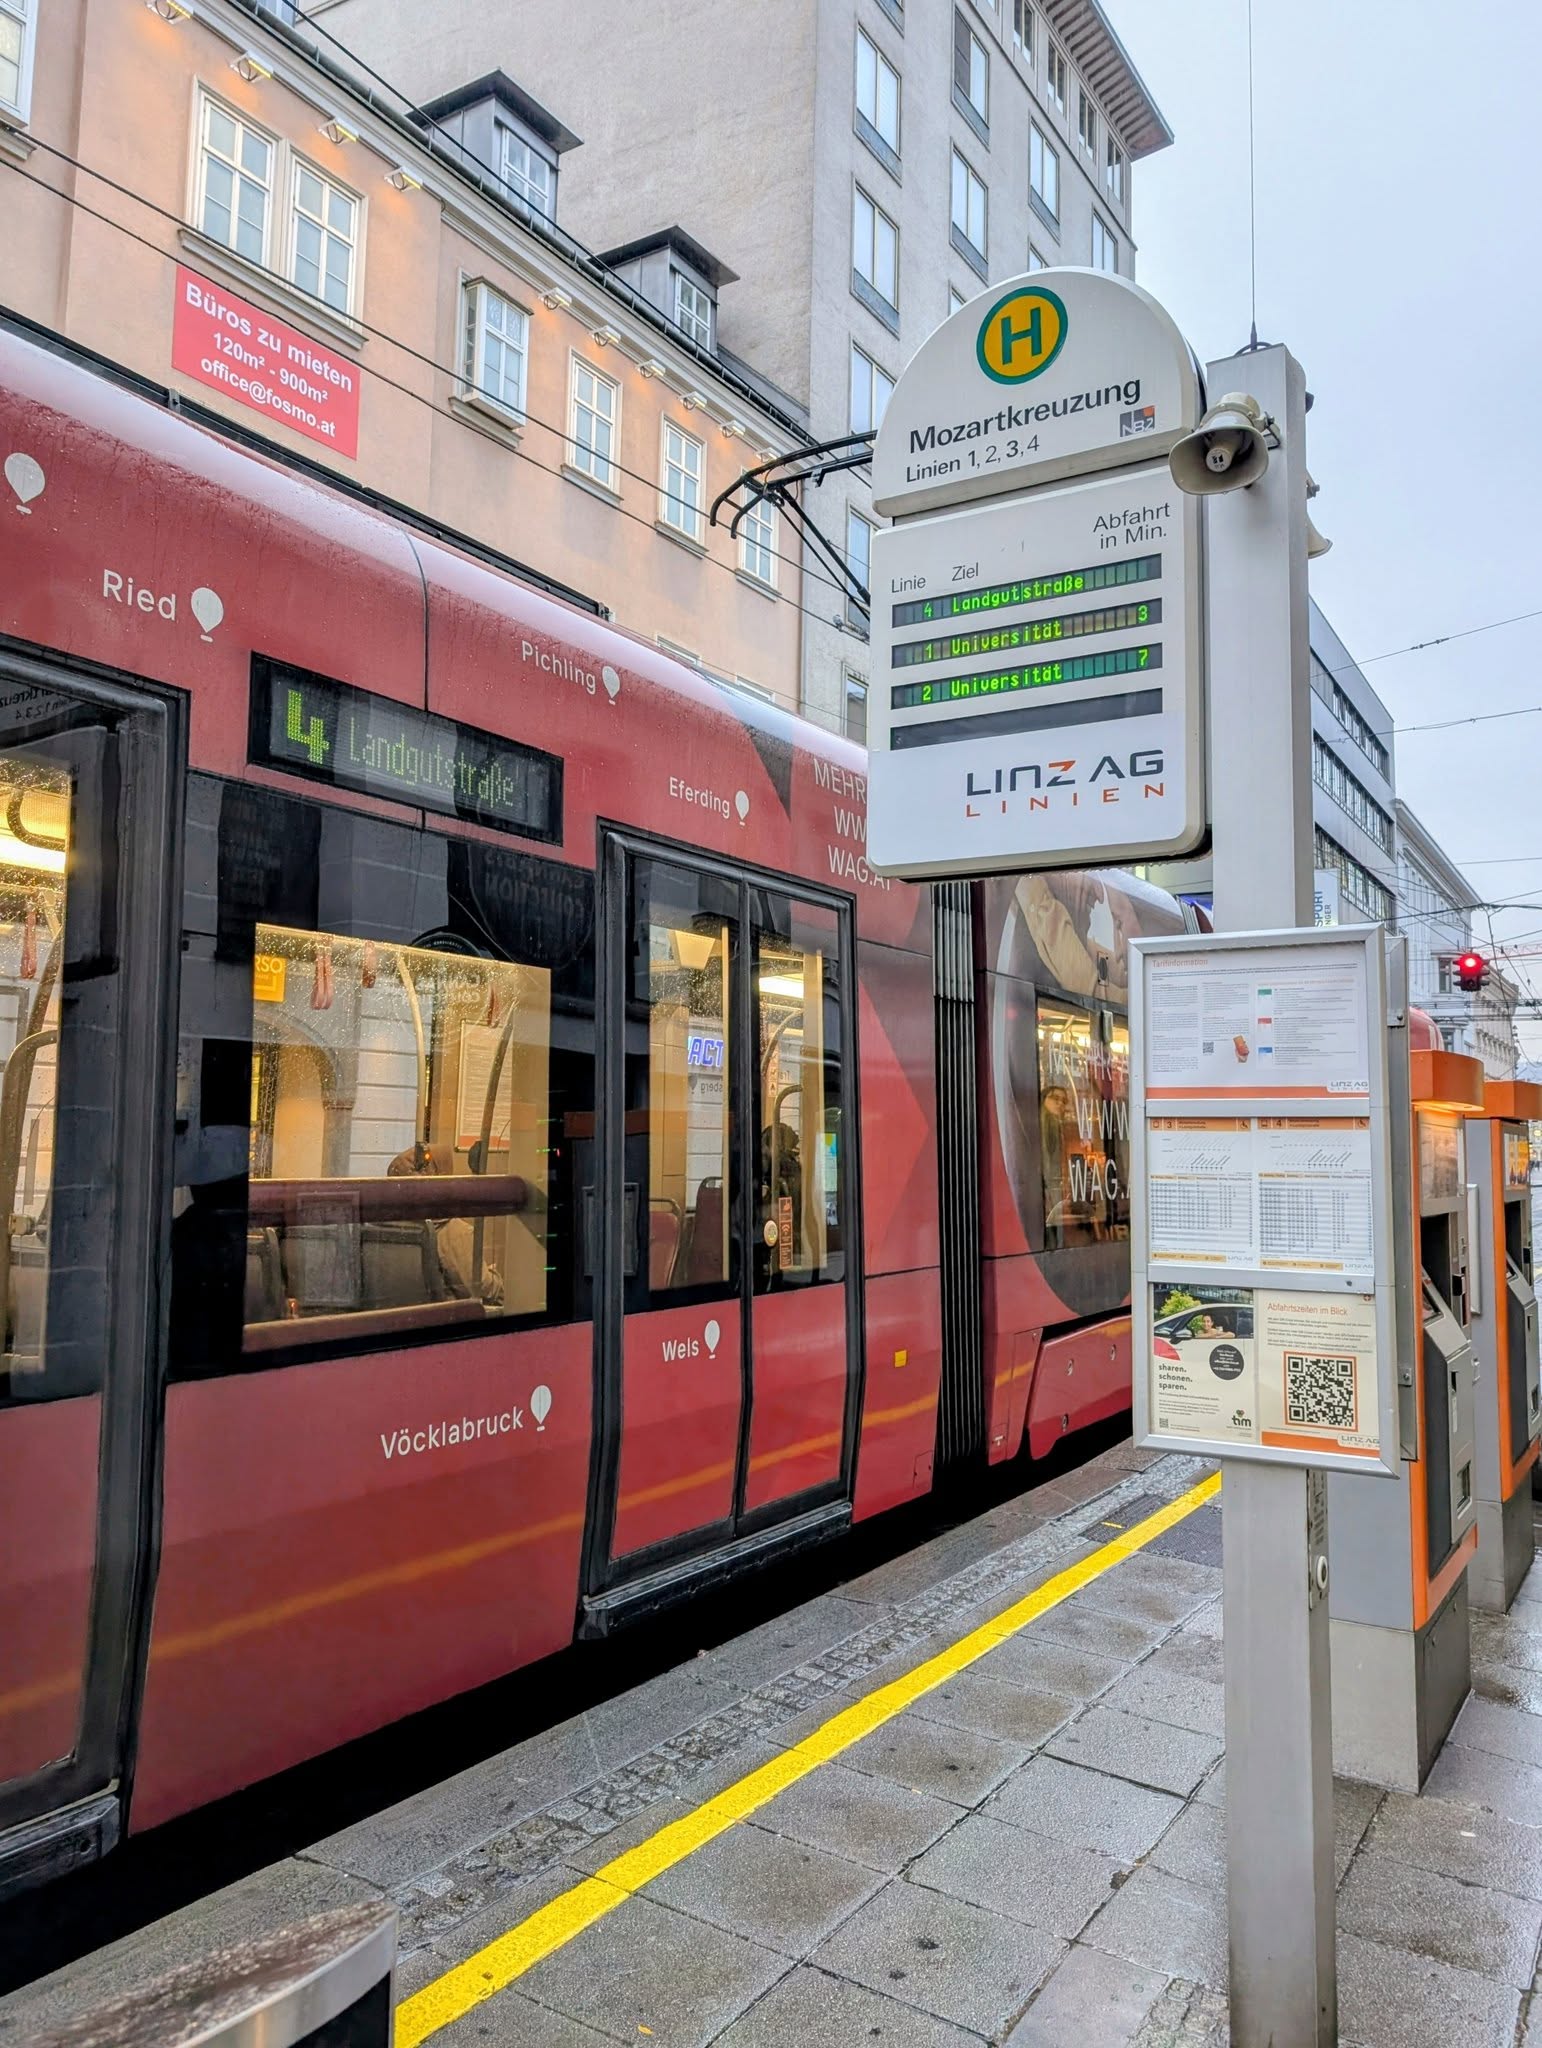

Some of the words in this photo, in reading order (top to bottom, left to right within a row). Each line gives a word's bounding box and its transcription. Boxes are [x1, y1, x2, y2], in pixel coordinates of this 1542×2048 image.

[186, 281, 251, 336] Büros
[257, 327, 281, 353] zu
[287, 343, 352, 393] mieten
[1000, 306, 1042, 366] H
[213, 332, 265, 370] 120m²
[279, 368, 328, 404] 900m²
[201, 358, 336, 437] office@fosmo.at
[909, 379, 1141, 454] Mozartkreuzung
[906, 457, 961, 483] Linien
[1093, 502, 1170, 532] Abfahrt
[1100, 534, 1117, 549] in
[1125, 525, 1167, 545] Min.
[102, 568, 176, 621] Ried
[891, 576, 926, 593] Linie
[952, 562, 979, 581] Ziel
[924, 602, 932, 618] 4
[952, 575, 1084, 613] Landgutstraße
[925, 643, 932, 659] 1
[952, 621, 1062, 655] Universität
[1138, 605, 1148, 621] 3
[521, 640, 596, 695] Pichling
[922, 685, 931, 701] 2
[951, 664, 1062, 697] Universität
[1138, 650, 1148, 667] 7
[287, 689, 329, 765] 4
[813, 758, 866, 804] MEHR
[966, 760, 1076, 796] LINZ
[1088, 749, 1163, 782] AG
[669, 776, 730, 819] Eferding
[966, 782, 1164, 817] LINIEN
[1267, 1303, 1318, 1314] Abfahrtszeiten
[1320, 1306, 1328, 1314] im
[1330, 1307, 1347, 1316] Blick
[661, 1337, 699, 1362] Wels
[1159, 1363, 1187, 1373] sharen.
[1159, 1372, 1193, 1382] schonen.
[1159, 1382, 1187, 1390] sparen.
[380, 1406, 524, 1460] Vöcklabruck
